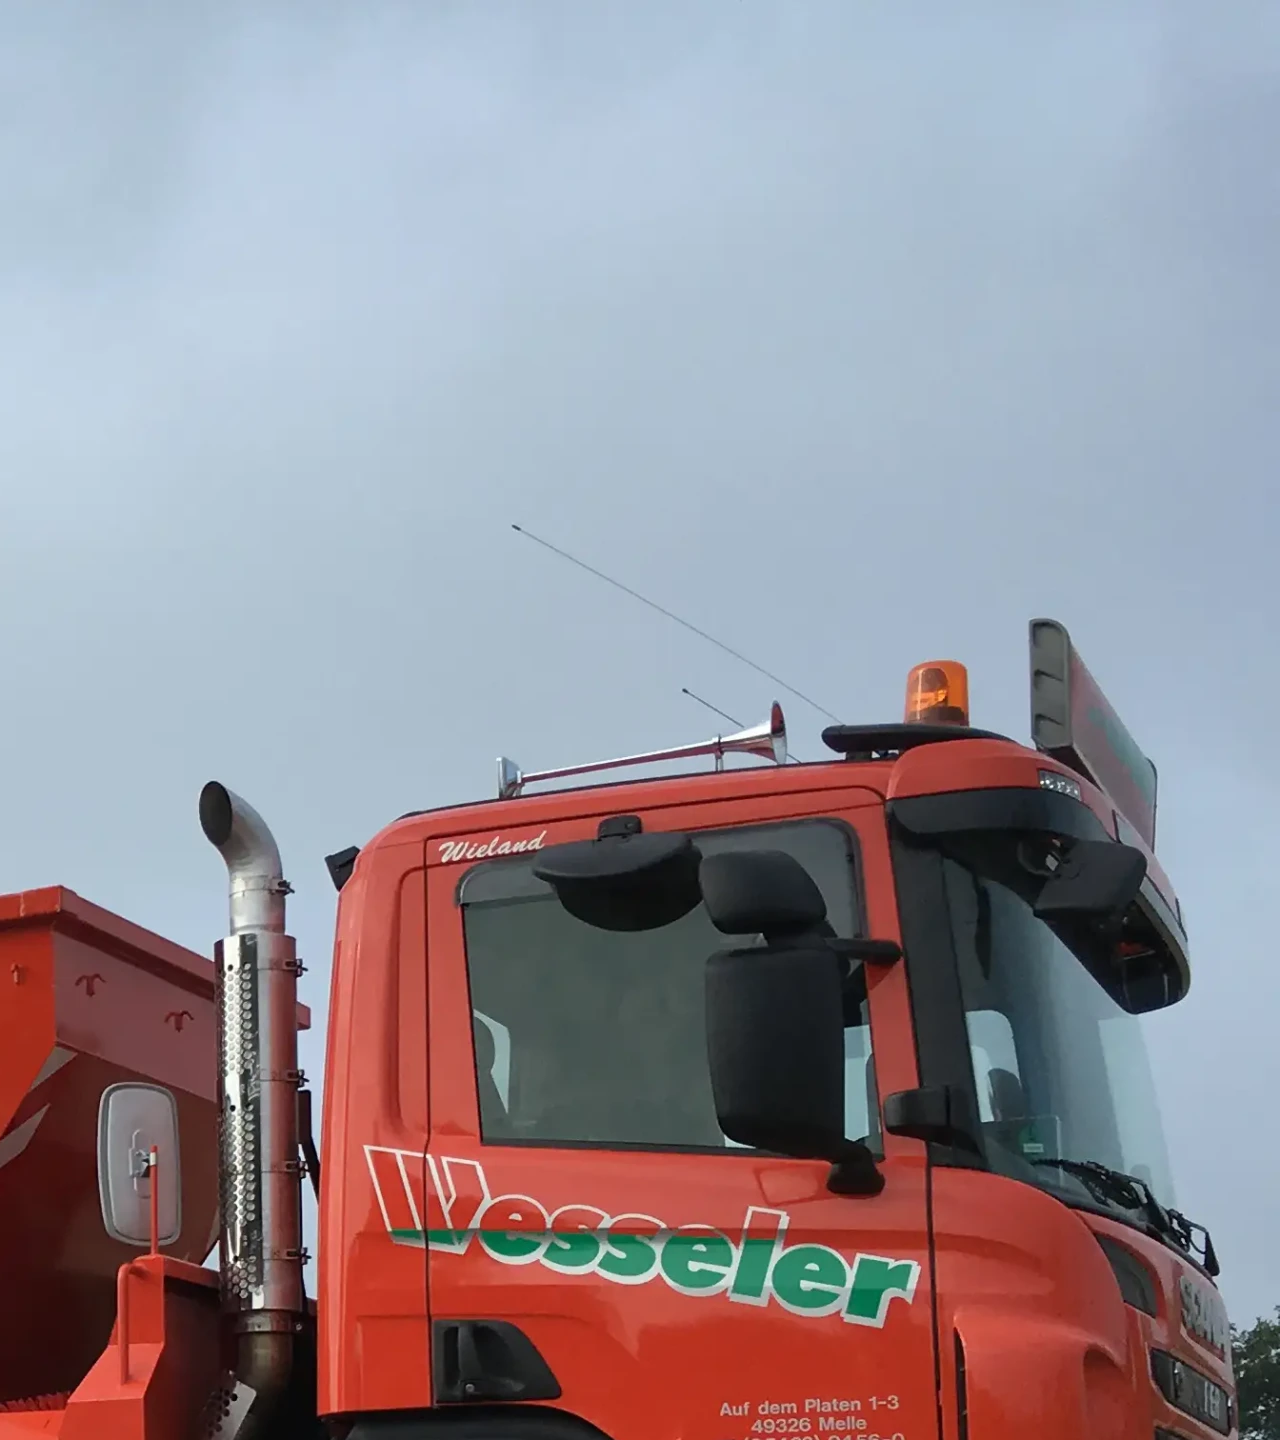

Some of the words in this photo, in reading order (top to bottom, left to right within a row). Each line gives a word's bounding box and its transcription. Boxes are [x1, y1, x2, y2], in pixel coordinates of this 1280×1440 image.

[438, 830, 547, 863] Wieland
[363, 1144, 922, 1328] Wesseler
[719, 1401, 750, 1417] Auf
[758, 1400, 797, 1415] dem
[804, 1398, 861, 1413] Platen
[868, 1395, 899, 1410] 1-3
[751, 1418, 811, 1434] 49326
[818, 1416, 867, 1431] Melle
